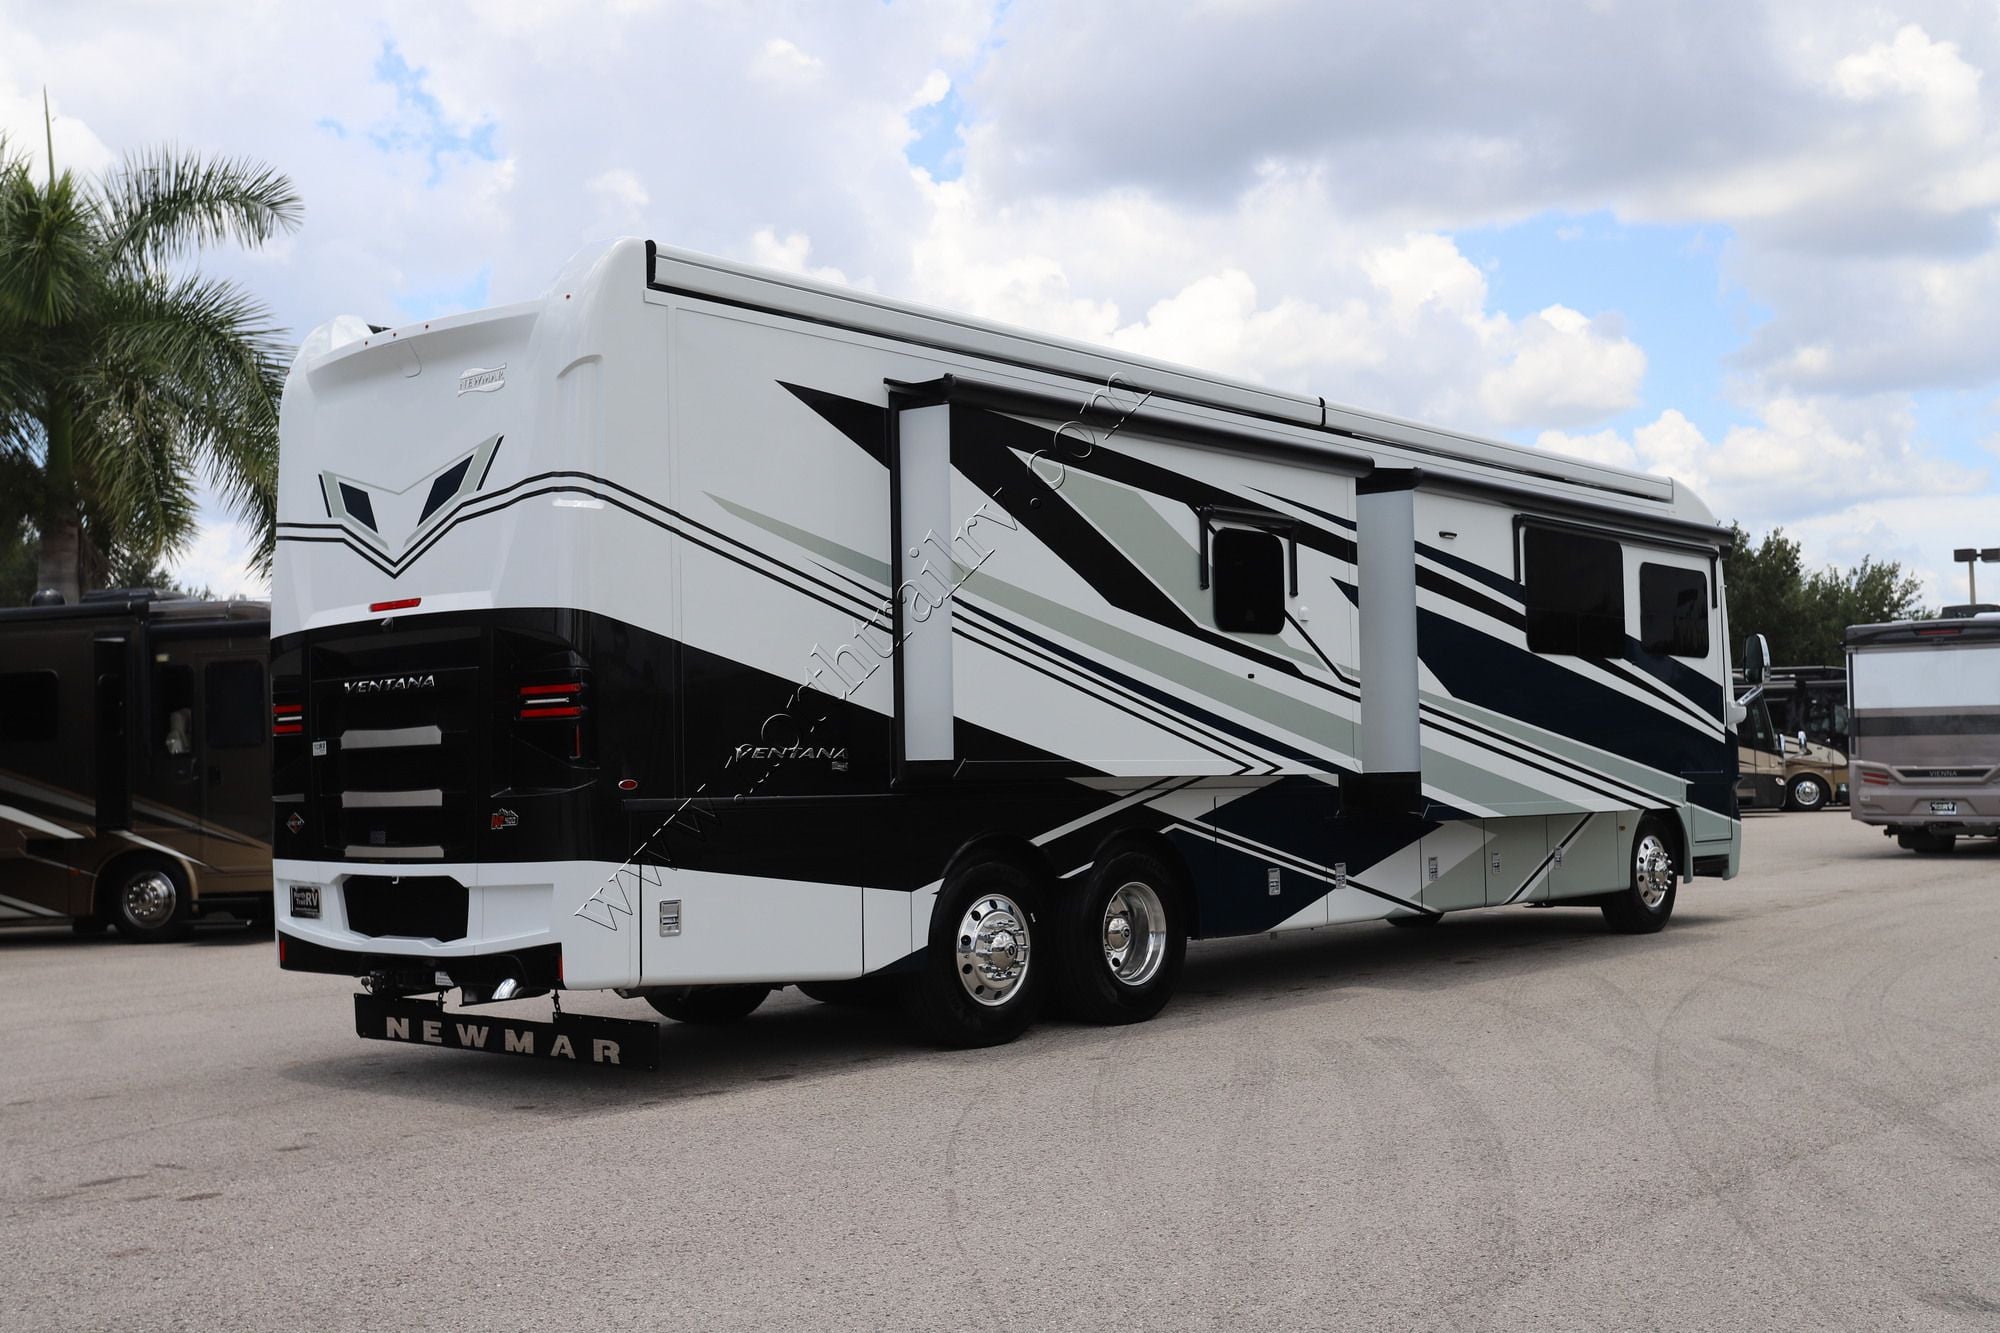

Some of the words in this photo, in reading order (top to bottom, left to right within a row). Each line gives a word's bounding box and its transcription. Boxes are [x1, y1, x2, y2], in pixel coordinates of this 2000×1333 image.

[459, 370, 505, 391] NEWMAR
[344, 674, 435, 694] VENTANA
[735, 746, 848, 760] VENTANA
[305, 891, 318, 907] RV
[386, 1016, 622, 1065] NEWMAR
